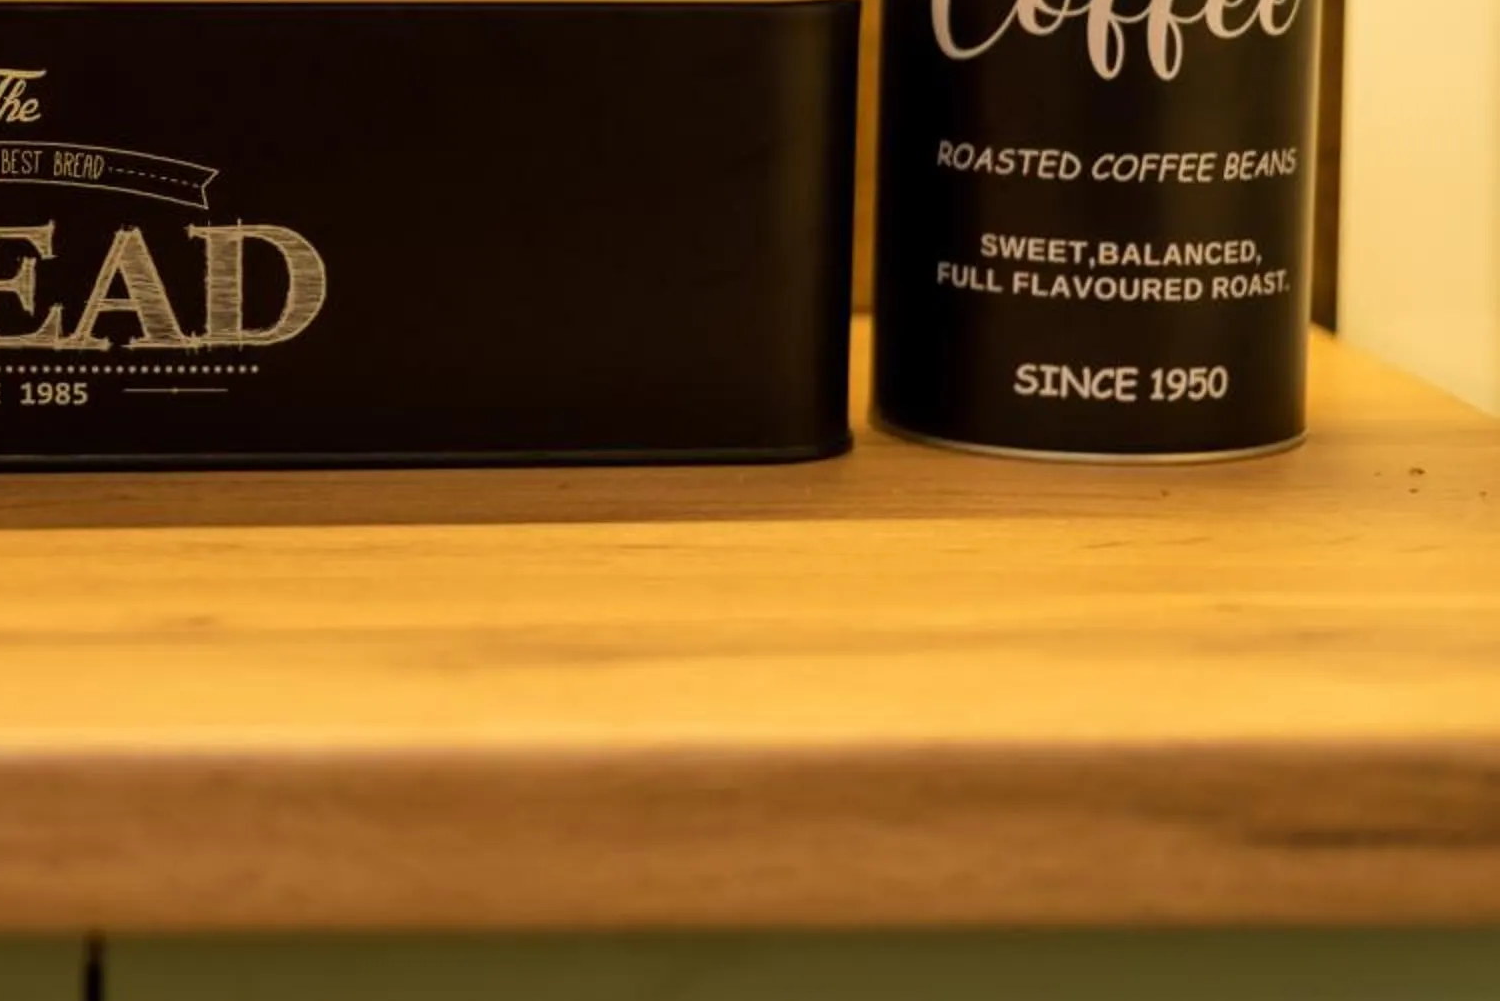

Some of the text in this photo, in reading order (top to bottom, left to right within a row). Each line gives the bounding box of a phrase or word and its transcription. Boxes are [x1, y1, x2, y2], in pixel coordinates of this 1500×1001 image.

[1, 150, 42, 175] BEST
[53, 151, 105, 180] BREAD
[937, 139, 1297, 183] ROASTED COFFEE BEANS
[937, 262, 1290, 302] FULL FLAVOURED ROAST.
[20, 381, 89, 405] 1985
[1014, 364, 1229, 401] SINCE 1950
